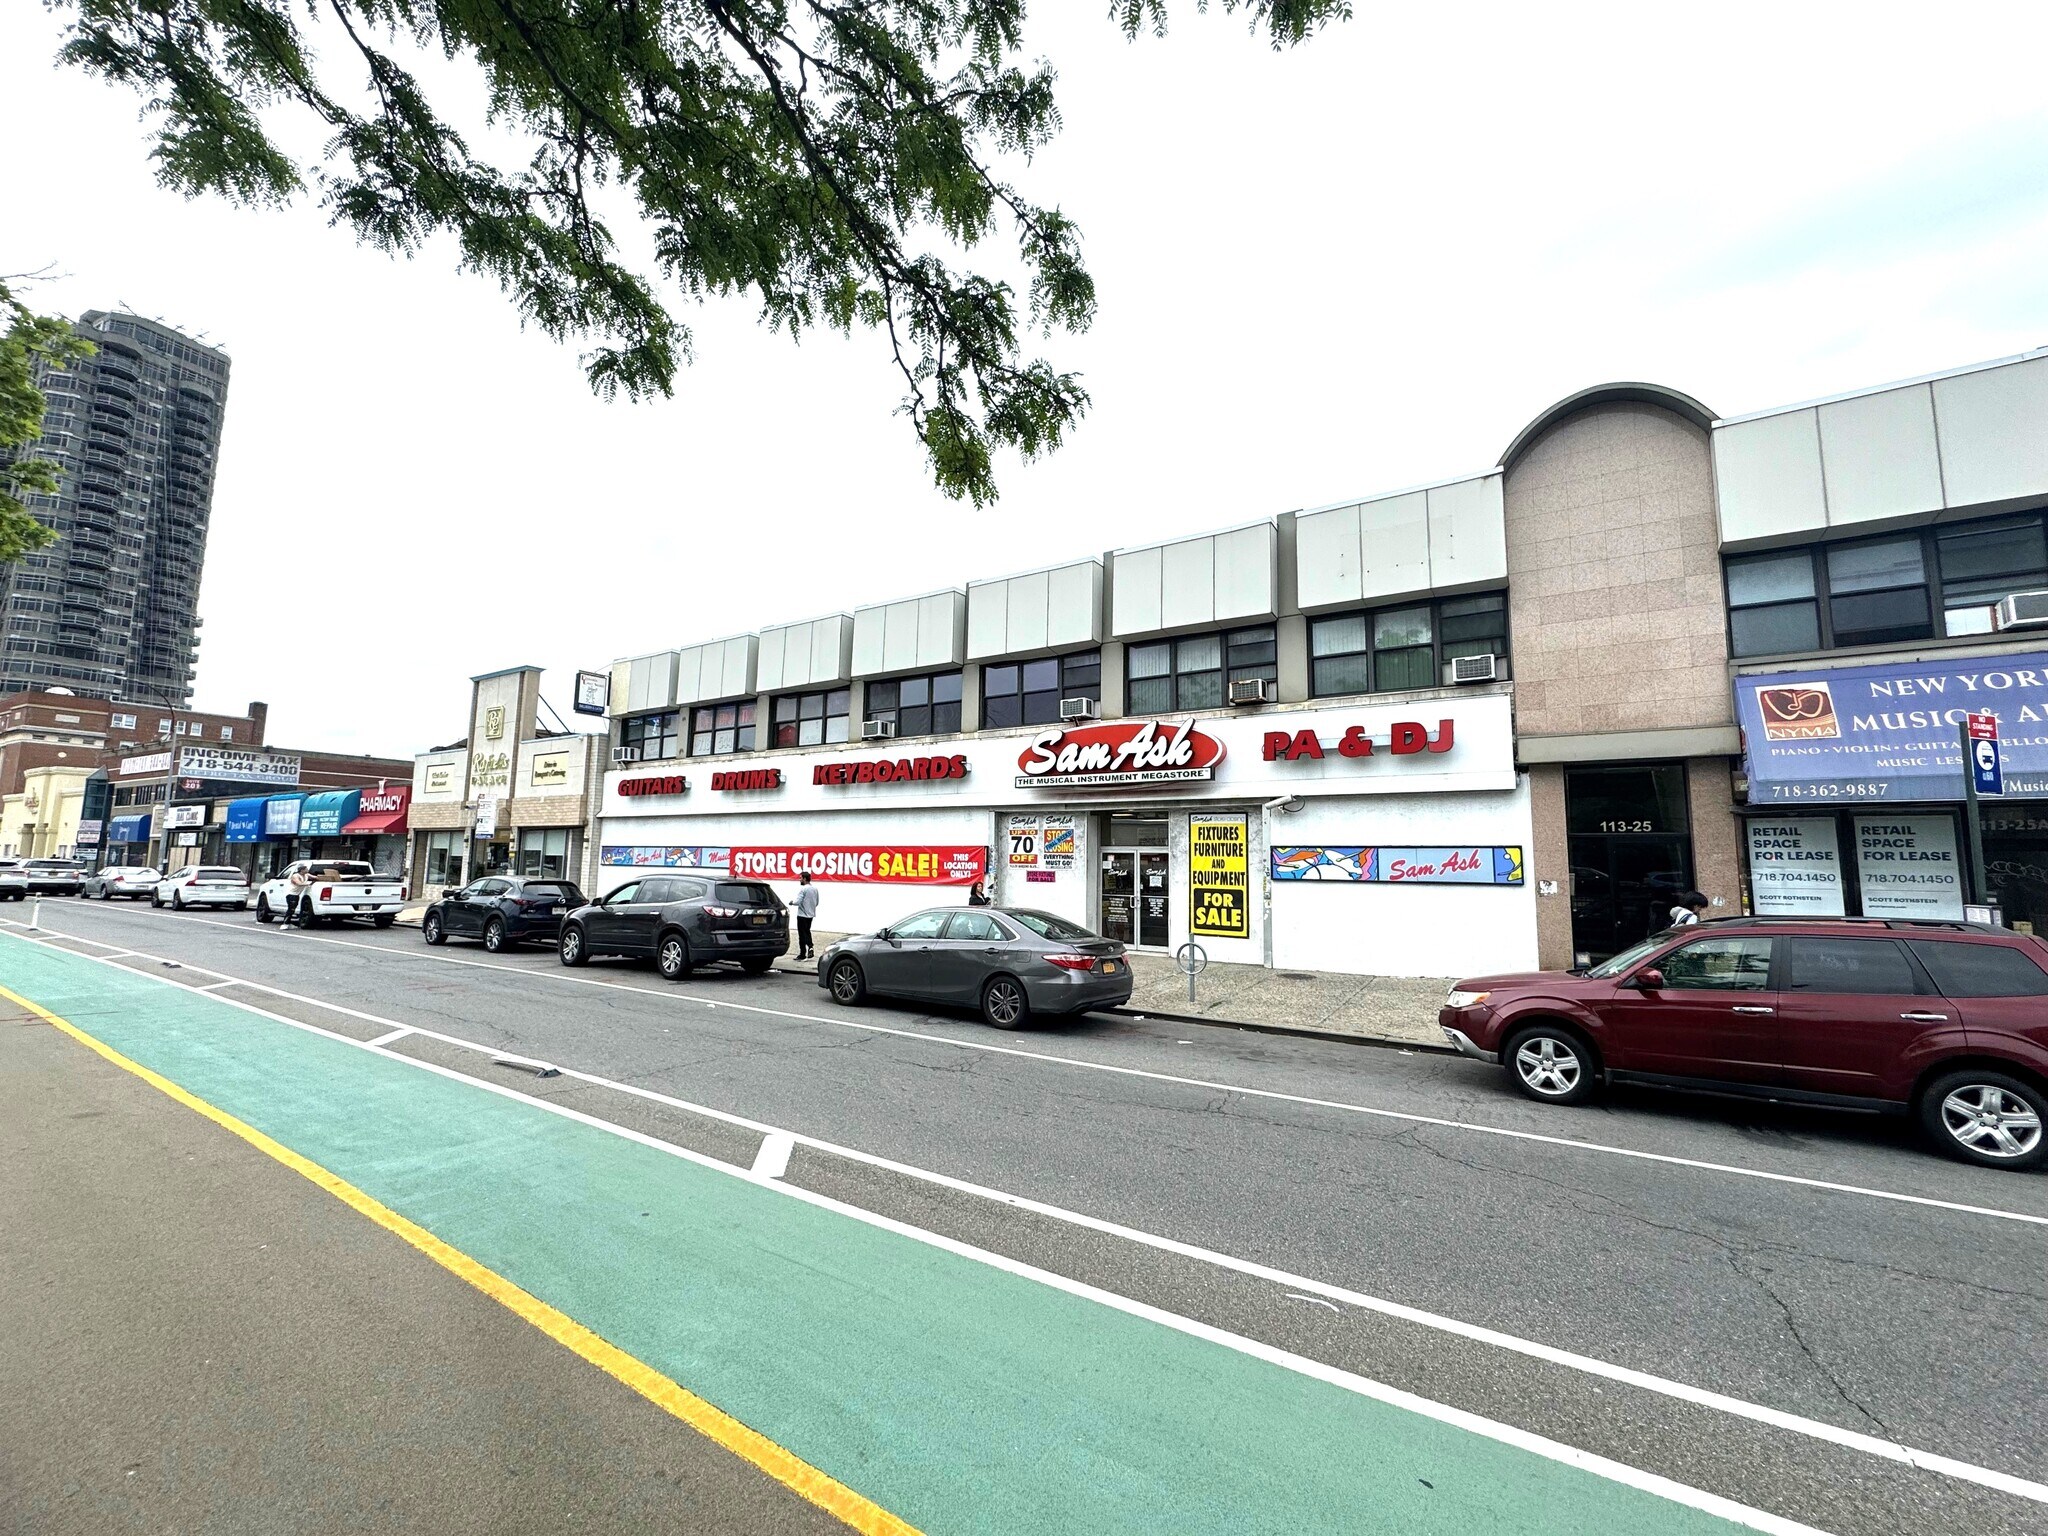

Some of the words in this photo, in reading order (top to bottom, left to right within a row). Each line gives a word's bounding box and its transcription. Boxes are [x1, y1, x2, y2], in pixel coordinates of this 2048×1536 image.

[1870, 676, 1946, 698] NEW
[1852, 708, 1966, 732] MUSIC
[1972, 723, 1994, 731] STANDING
[1769, 726, 1835, 739] NYMA
[1024, 729, 1111, 775] Sam
[1110, 718, 1196, 771] Ash
[1263, 730, 1325, 761] PA
[1338, 726, 1374, 758] &
[1390, 719, 1454, 755] DJ
[1771, 746, 1821, 757] PIANO
[1836, 743, 1892, 754] VIOLIN
[1904, 740, 1962, 752] GUITA
[2001, 736, 2048, 748] ELLO
[183, 748, 261, 762] INCOME
[267, 755, 299, 766] TAX
[1876, 756, 1928, 768] MUSIC
[813, 754, 968, 786] KEYBOARDS
[232, 772, 252, 780] TAX
[257, 775, 297, 783] GROUP
[711, 768, 782, 791] DRUMS
[1018, 778, 1034, 786] THE
[1036, 776, 1075, 785] MUSICAL
[1077, 774, 1139, 783] INSTRUMENT
[1141, 770, 1204, 780] MEGASTORE
[618, 775, 687, 797] GUITARS
[1772, 783, 1889, 798] 718-362-9887
[359, 795, 403, 812] PHARMACY
[1011, 816, 1025, 825] Sam
[1024, 815, 1038, 826] Ash
[1045, 815, 1059, 825] Sam
[1059, 815, 1073, 826] Ash
[1600, 820, 1652, 832] 113-25
[1198, 826, 1239, 841] FIXTURES
[1752, 827, 1802, 837] RETAIL
[1861, 826, 1916, 836] RETAIL
[1194, 842, 1244, 857] FURNITURE
[1753, 839, 1802, 849] SPACE
[1861, 838, 1915, 849] SPACE
[635, 853, 650, 864] Sam
[650, 849, 663, 861] Ash
[953, 853, 969, 862] THIS
[1012, 854, 1035, 862] OFF
[1755, 851, 1784, 861] FOR
[1787, 851, 1834, 861] LEASE
[1863, 851, 1896, 861] FOR
[1900, 851, 1951, 861] LEASE
[734, 851, 787, 875] STORE
[794, 851, 873, 877] CLOSING
[878, 853, 939, 878] SALE!
[943, 861, 978, 870] LOCATION
[1211, 859, 1225, 869] AND
[1389, 859, 1436, 881] Sam
[1439, 849, 1482, 876] Ash
[950, 869, 972, 879] ONLY!
[1193, 871, 1245, 886] EQUIPMENT
[1756, 872, 1836, 883] 718.704.1450
[1865, 873, 1954, 885] 718.704.1450
[1203, 892, 1234, 908] FOR
[1196, 907, 1242, 927] SALE
